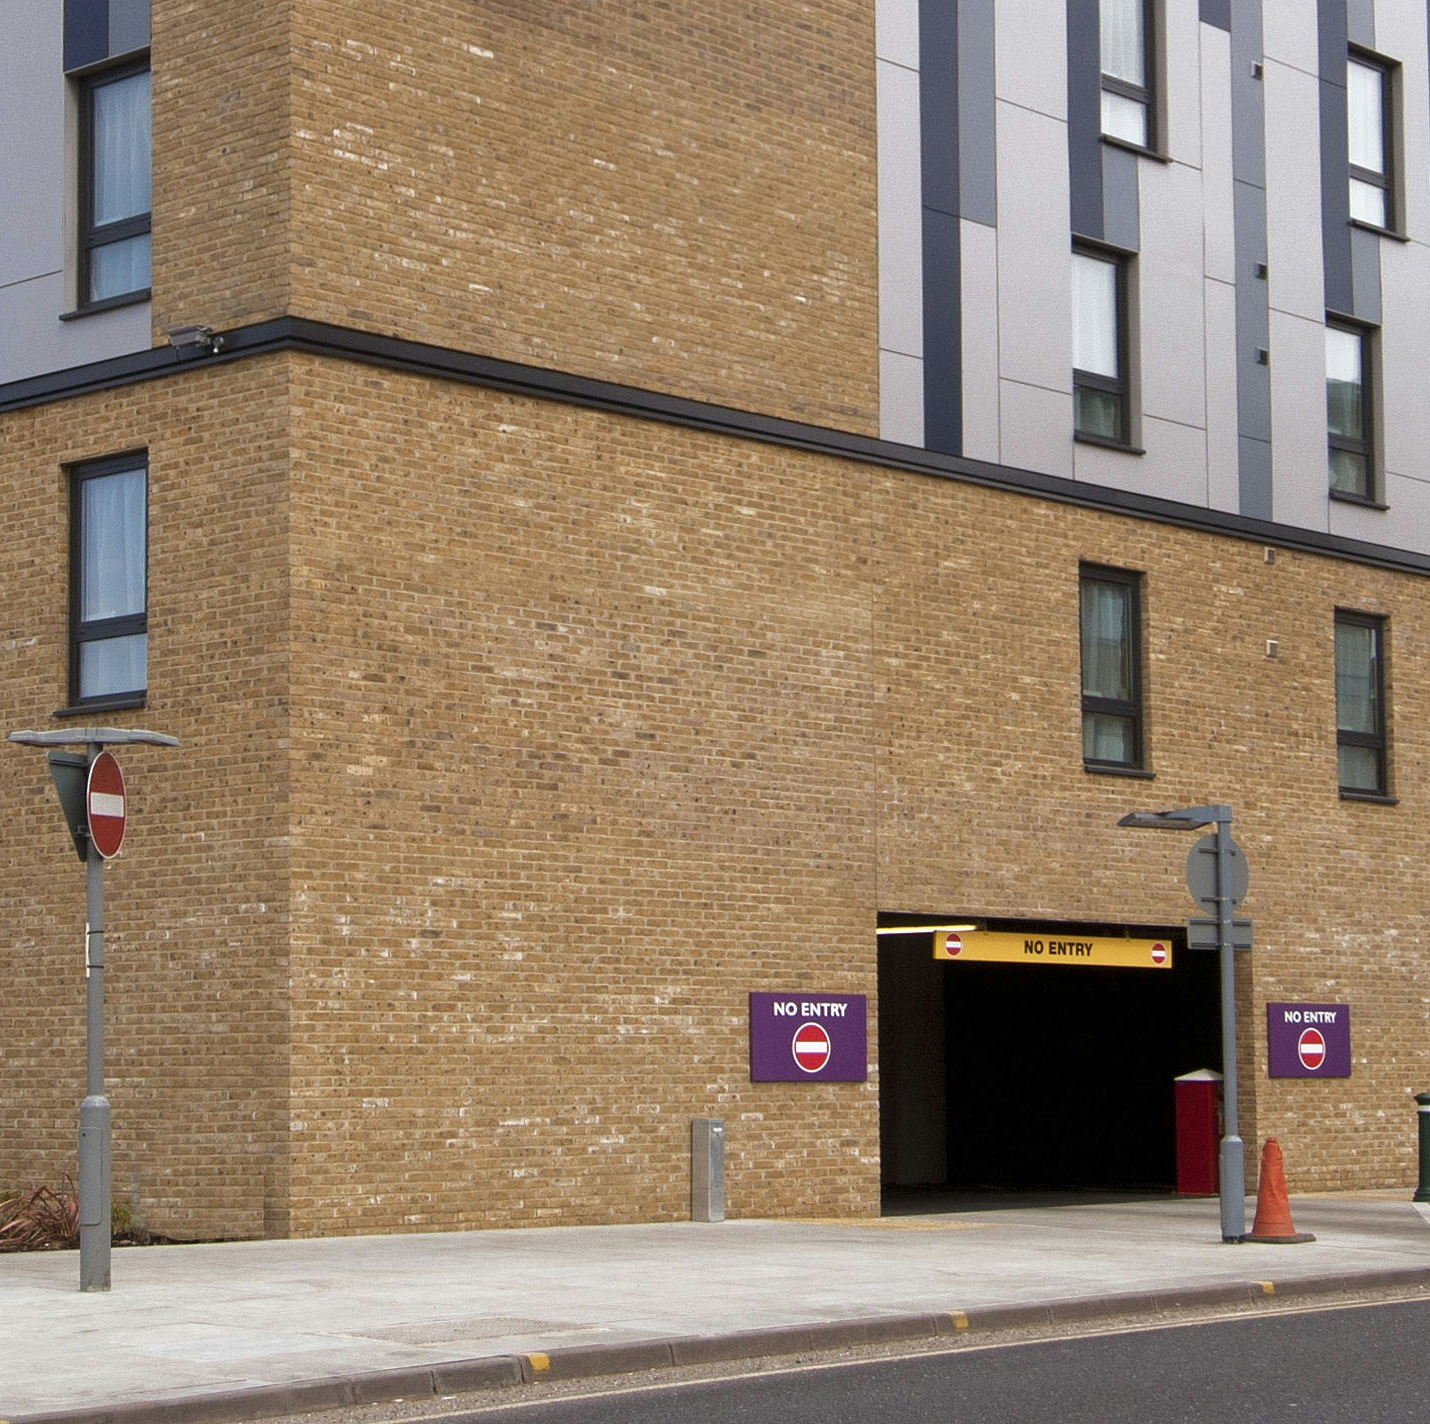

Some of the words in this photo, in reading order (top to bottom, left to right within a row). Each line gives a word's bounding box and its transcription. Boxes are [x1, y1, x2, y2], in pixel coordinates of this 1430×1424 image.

[1024, 940, 1044, 955] NO
[1048, 941, 1093, 956] ENTRY
[773, 1002, 798, 1016] NO
[801, 1002, 848, 1017] ENTRY
[1284, 1011, 1302, 1023] NO
[1303, 1011, 1337, 1024] ENTRY
